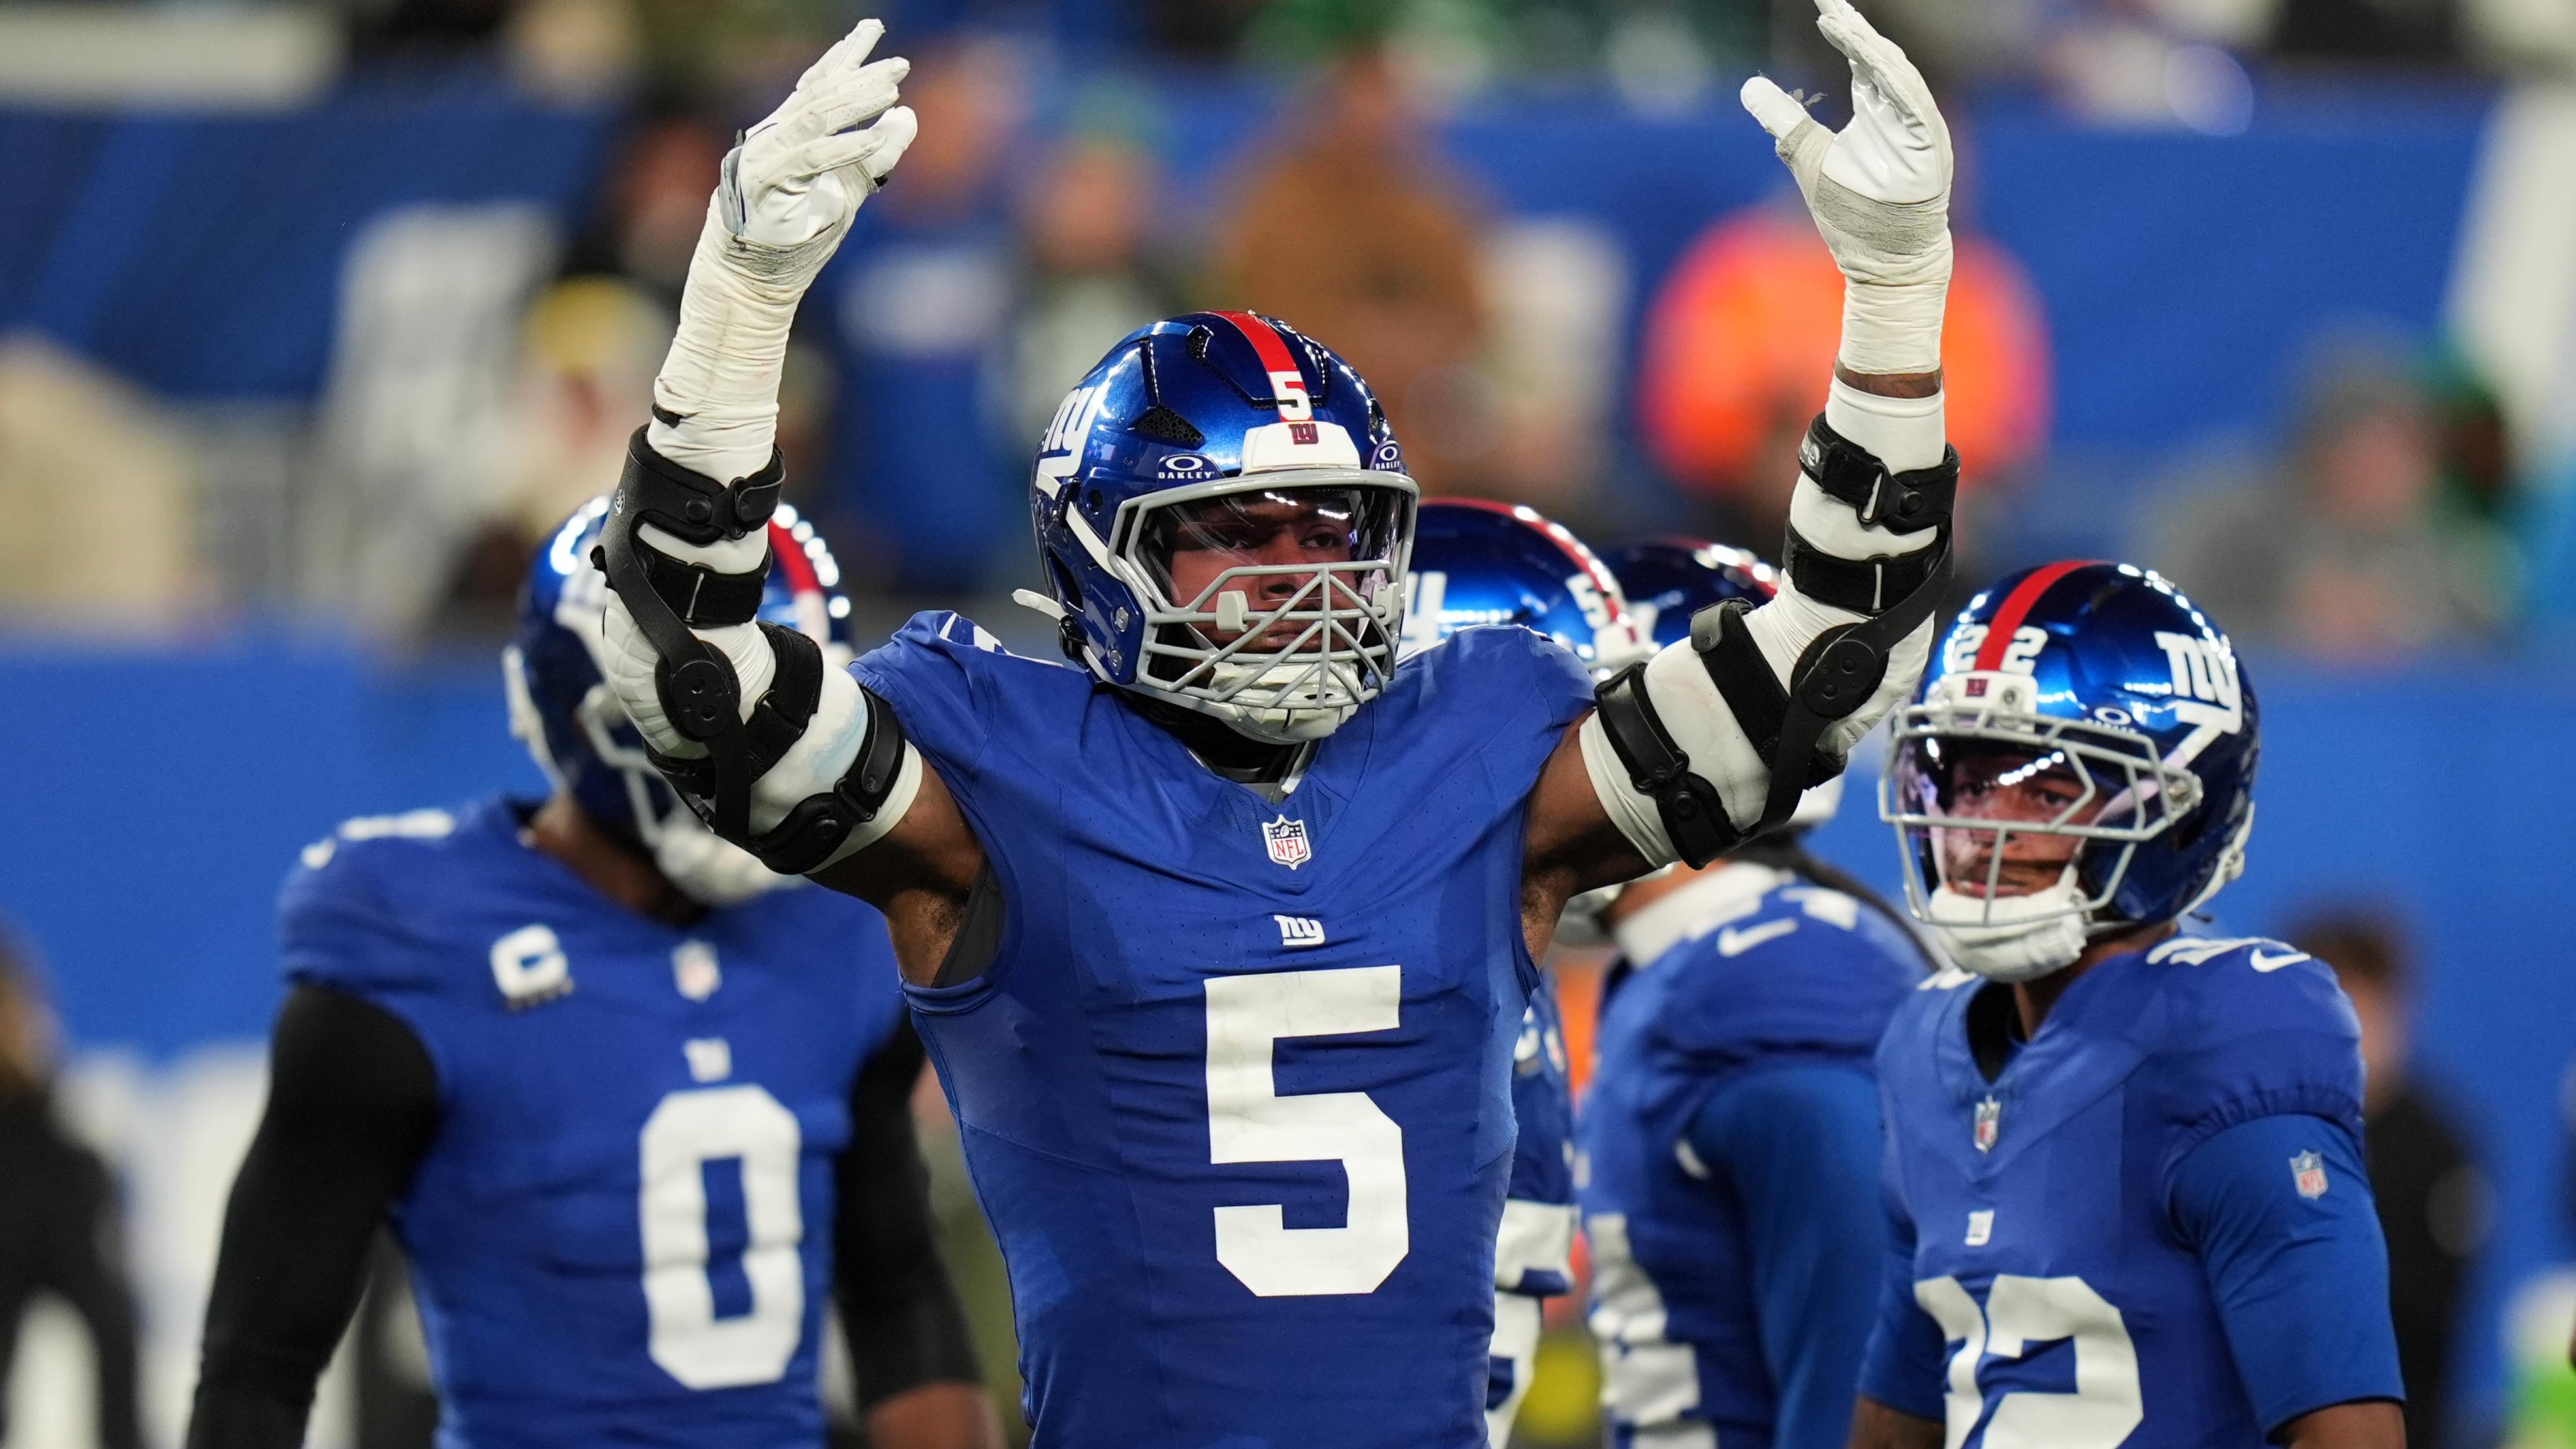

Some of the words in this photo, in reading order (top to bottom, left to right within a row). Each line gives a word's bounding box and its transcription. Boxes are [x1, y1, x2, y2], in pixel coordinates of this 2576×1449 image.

[1267, 370, 1312, 421] 5
[1375, 460, 1400, 470] OAKLEY
[1951, 623, 2049, 676] 22
[1275, 838, 1304, 859] NFL
[1204, 965, 1409, 1298] 5
[638, 1083, 804, 1390] 0
